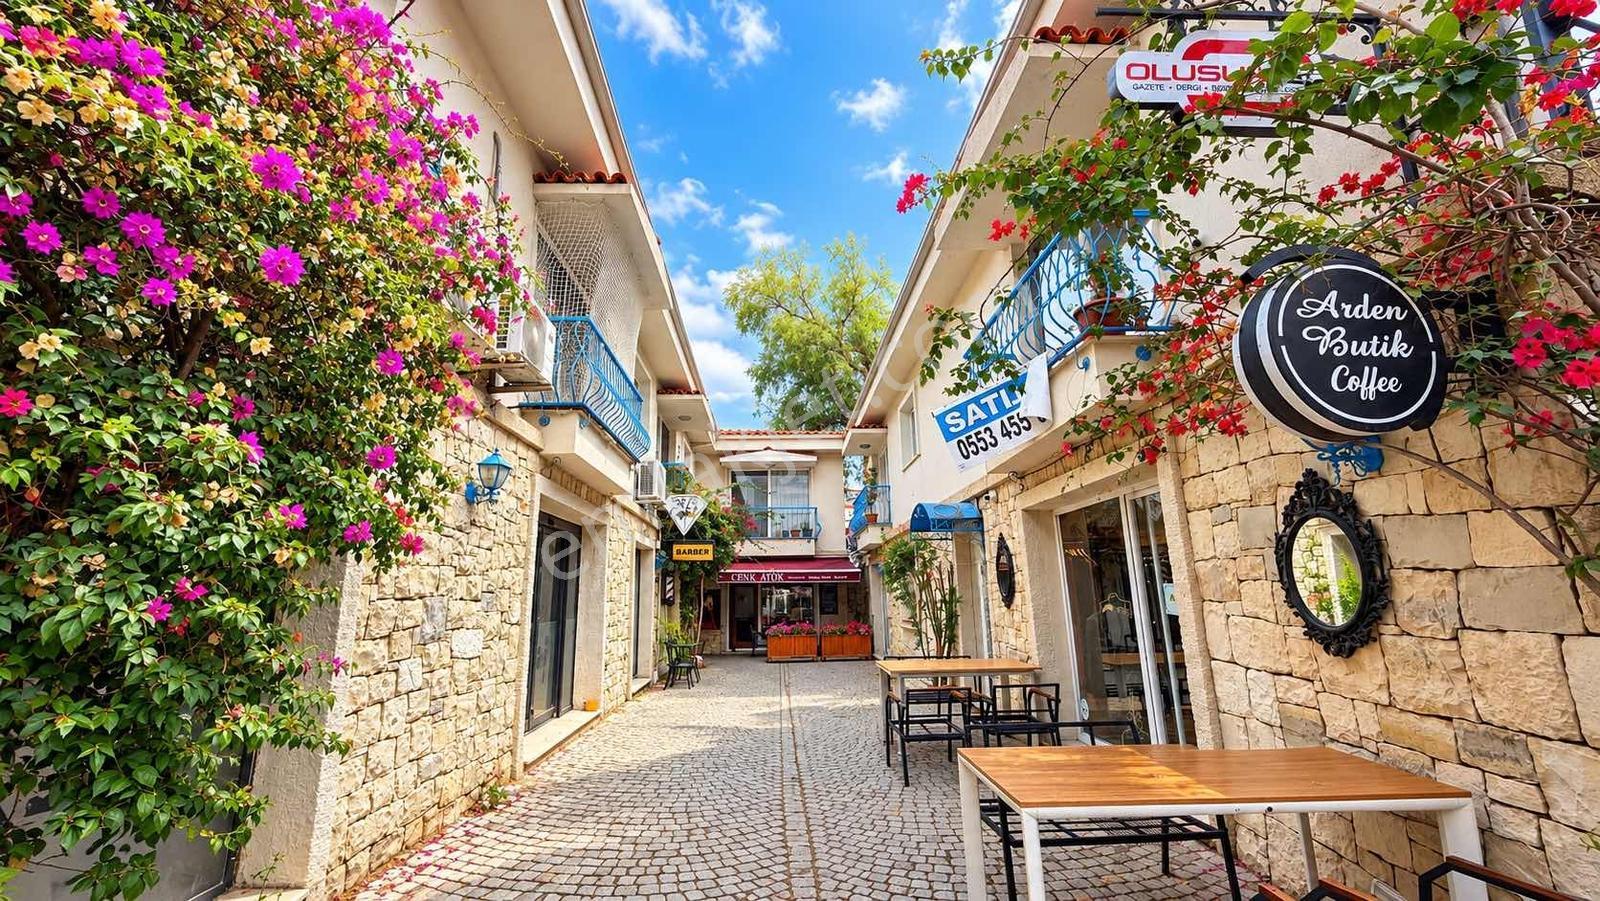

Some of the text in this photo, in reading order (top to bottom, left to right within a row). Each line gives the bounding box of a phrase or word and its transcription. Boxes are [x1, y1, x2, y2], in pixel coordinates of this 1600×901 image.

[1132, 83, 1165, 91] GAZETE
[1297, 290, 1408, 320] Arden
[1302, 325, 1414, 357] Butik
[1331, 365, 1402, 400] Coffee
[957, 412, 1032, 460] 0553 455
[731, 573, 756, 581] CENK
